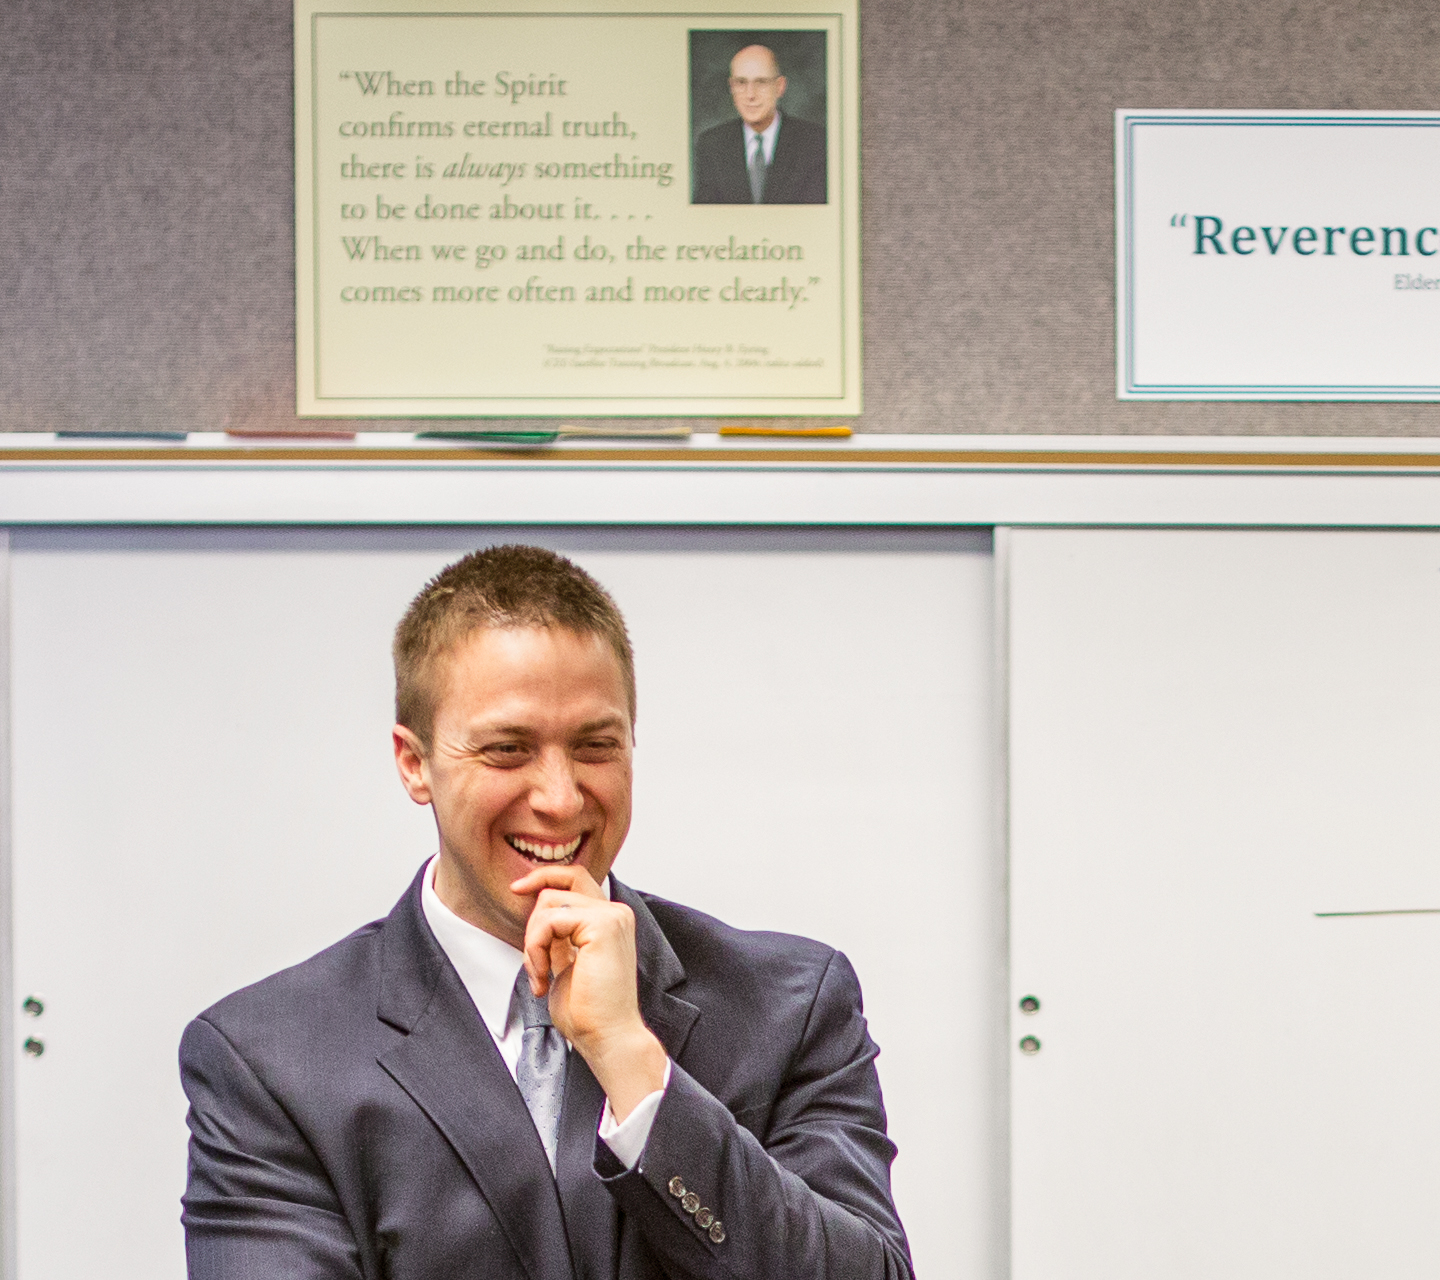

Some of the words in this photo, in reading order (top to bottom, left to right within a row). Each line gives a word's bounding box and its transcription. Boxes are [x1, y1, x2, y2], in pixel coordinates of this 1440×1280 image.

[444, 69, 487, 98] the
[494, 70, 568, 106] Spirit
[337, 110, 455, 139] confirms
[462, 111, 553, 139] eternal
[561, 110, 638, 141] truth,
[339, 152, 407, 181] there
[414, 155, 435, 180] is
[441, 152, 528, 188] always
[533, 152, 675, 189] something
[339, 284, 424, 303] comes
[431, 284, 501, 304] more
[506, 274, 577, 304] often
[584, 274, 635, 303] and
[642, 284, 712, 303] more
